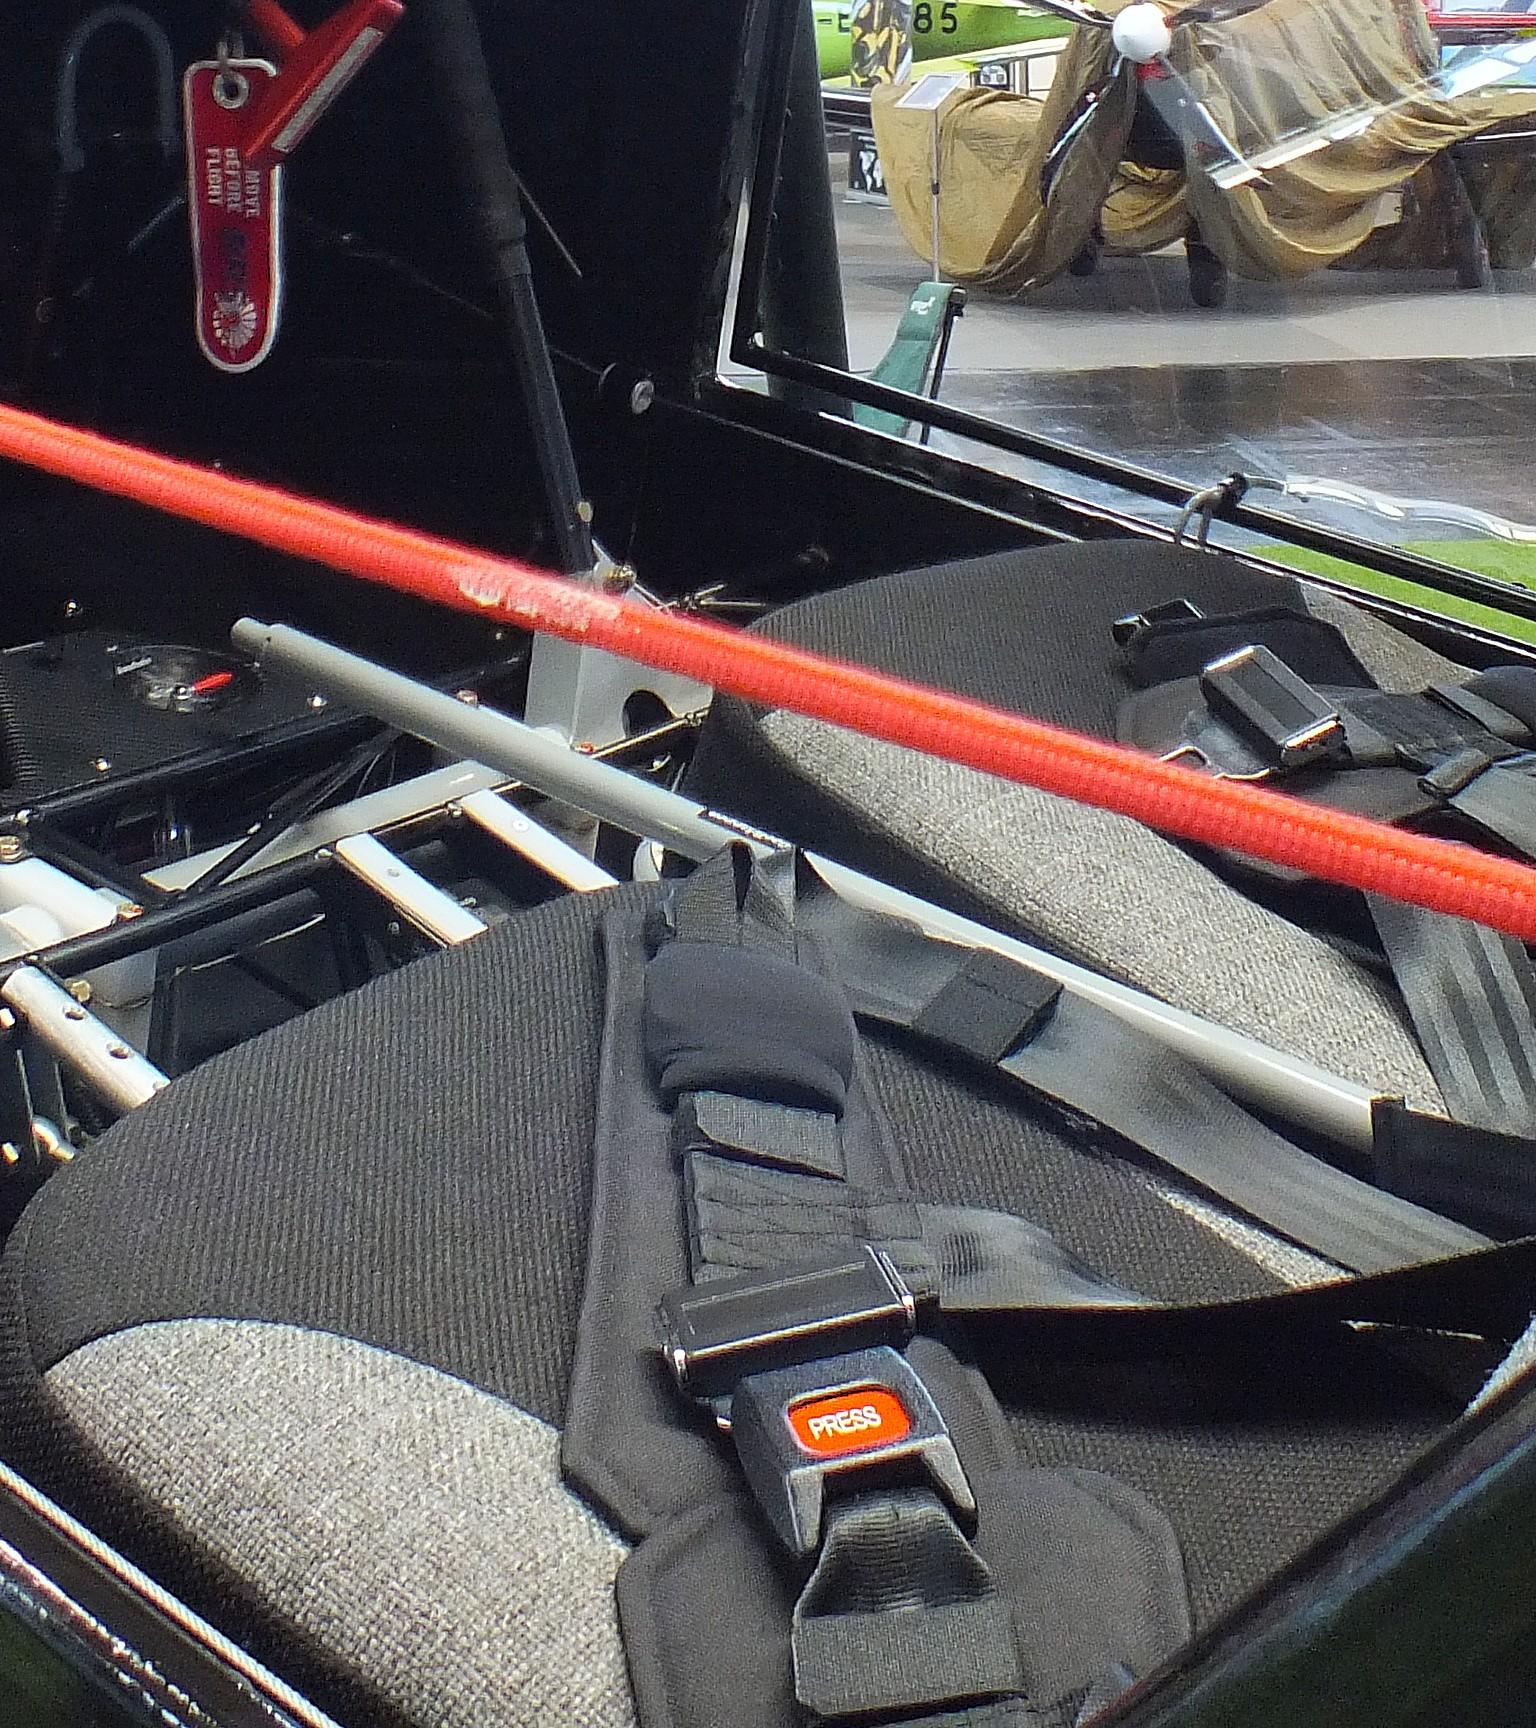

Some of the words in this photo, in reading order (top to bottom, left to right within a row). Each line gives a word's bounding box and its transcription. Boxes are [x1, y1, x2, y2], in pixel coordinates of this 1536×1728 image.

[206, 147, 224, 207] FLIGHT
[223, 147, 244, 214] BEFORE
[244, 170, 261, 217] MOVE
[808, 1405, 883, 1441] PRESS
